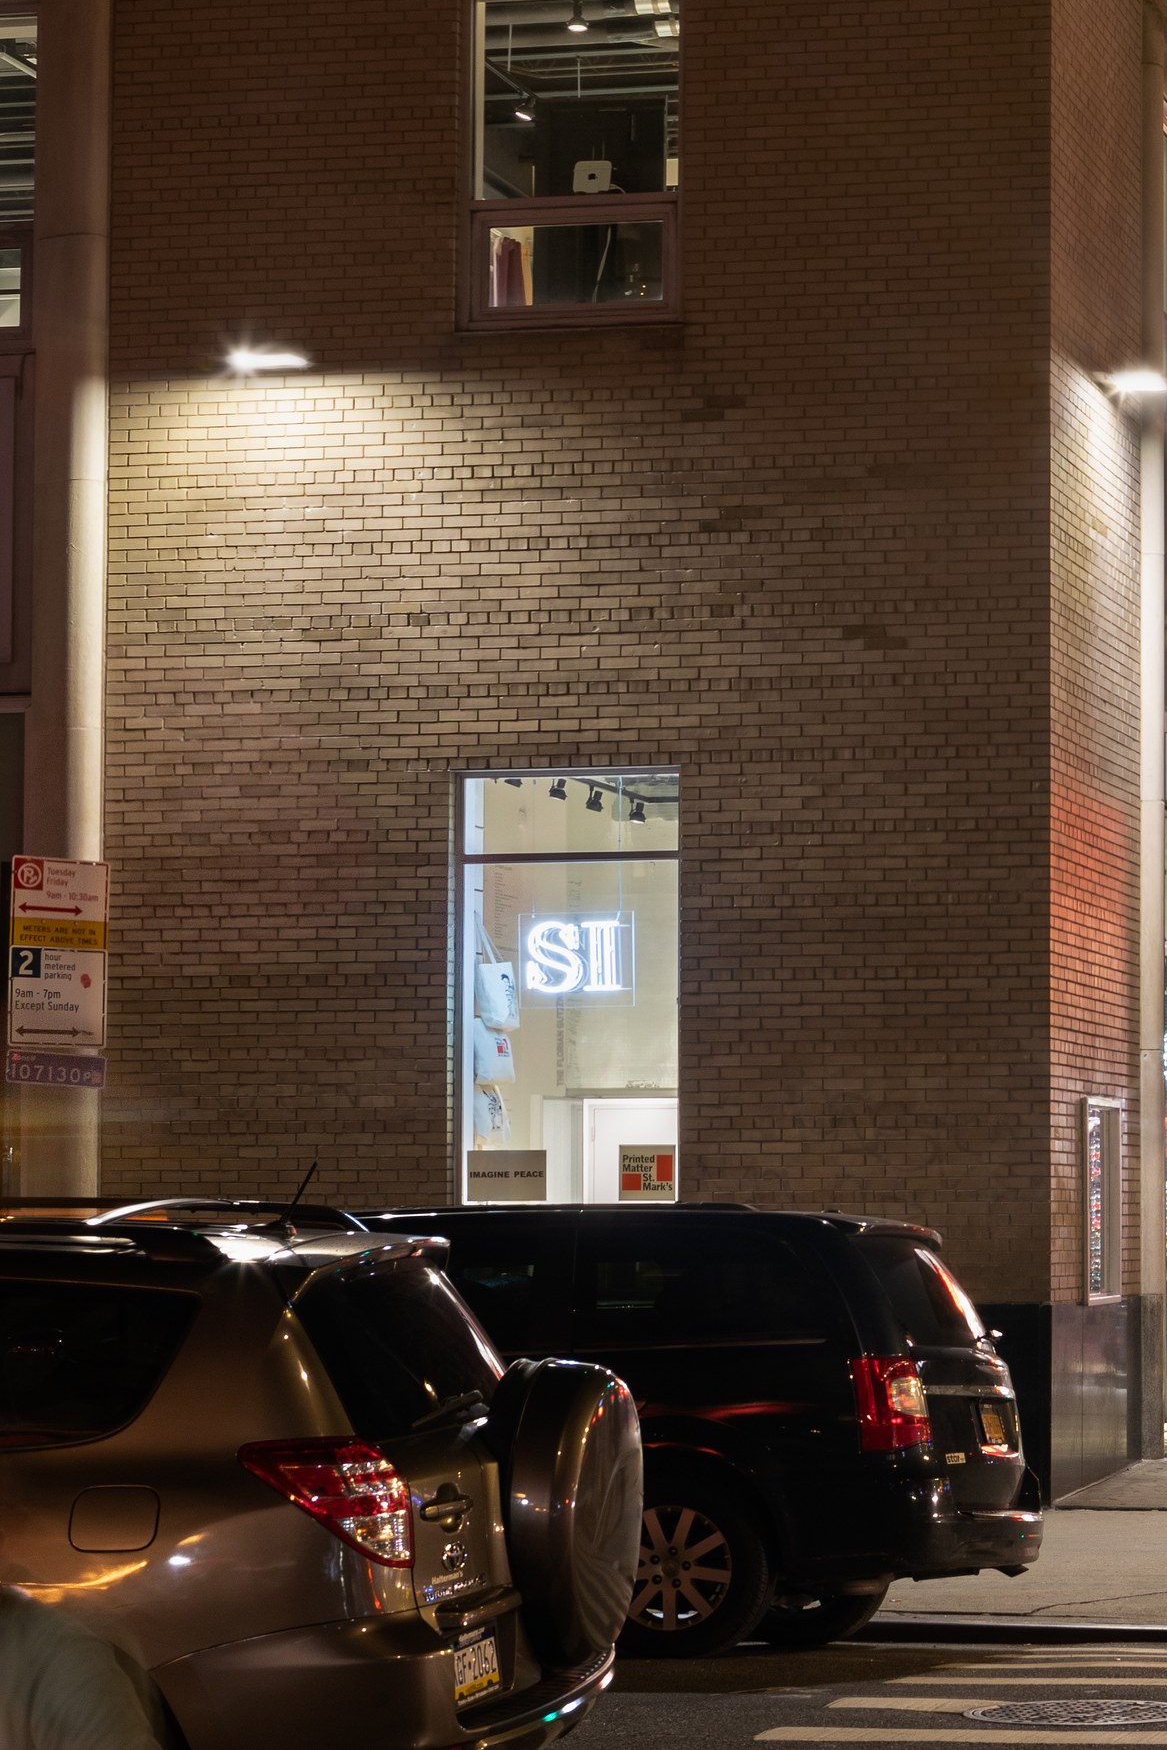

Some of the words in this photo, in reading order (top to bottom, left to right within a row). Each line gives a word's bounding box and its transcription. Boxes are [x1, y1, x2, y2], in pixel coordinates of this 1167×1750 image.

[47, 867, 76, 878] Tuesday
[46, 877, 69, 887] Friday
[46, 891, 62, 900] 9am
[23, 925, 51, 934] METERS
[54, 927, 68, 935] ARE
[20, 934, 46, 942] EFFECT
[50, 936, 74, 944] ABOVE
[44, 952, 62, 961] hour
[526, 920, 627, 993] SI
[19, 950, 34, 975] 2
[44, 962, 76, 971] metered
[44, 972, 72, 981] parking
[15, 988, 34, 998] 9am
[43, 989, 61, 1000] 7pm
[15, 1001, 45, 1011] Except
[48, 1002, 80, 1013] Sunday
[622, 1154, 655, 1164] Printed
[622, 1164, 653, 1173] Matter
[469, 1170, 510, 1179] IMAGINE
[514, 1170, 544, 1178] PEACE
[642, 1173, 655, 1182] St.
[642, 1182, 673, 1191] Mark's
